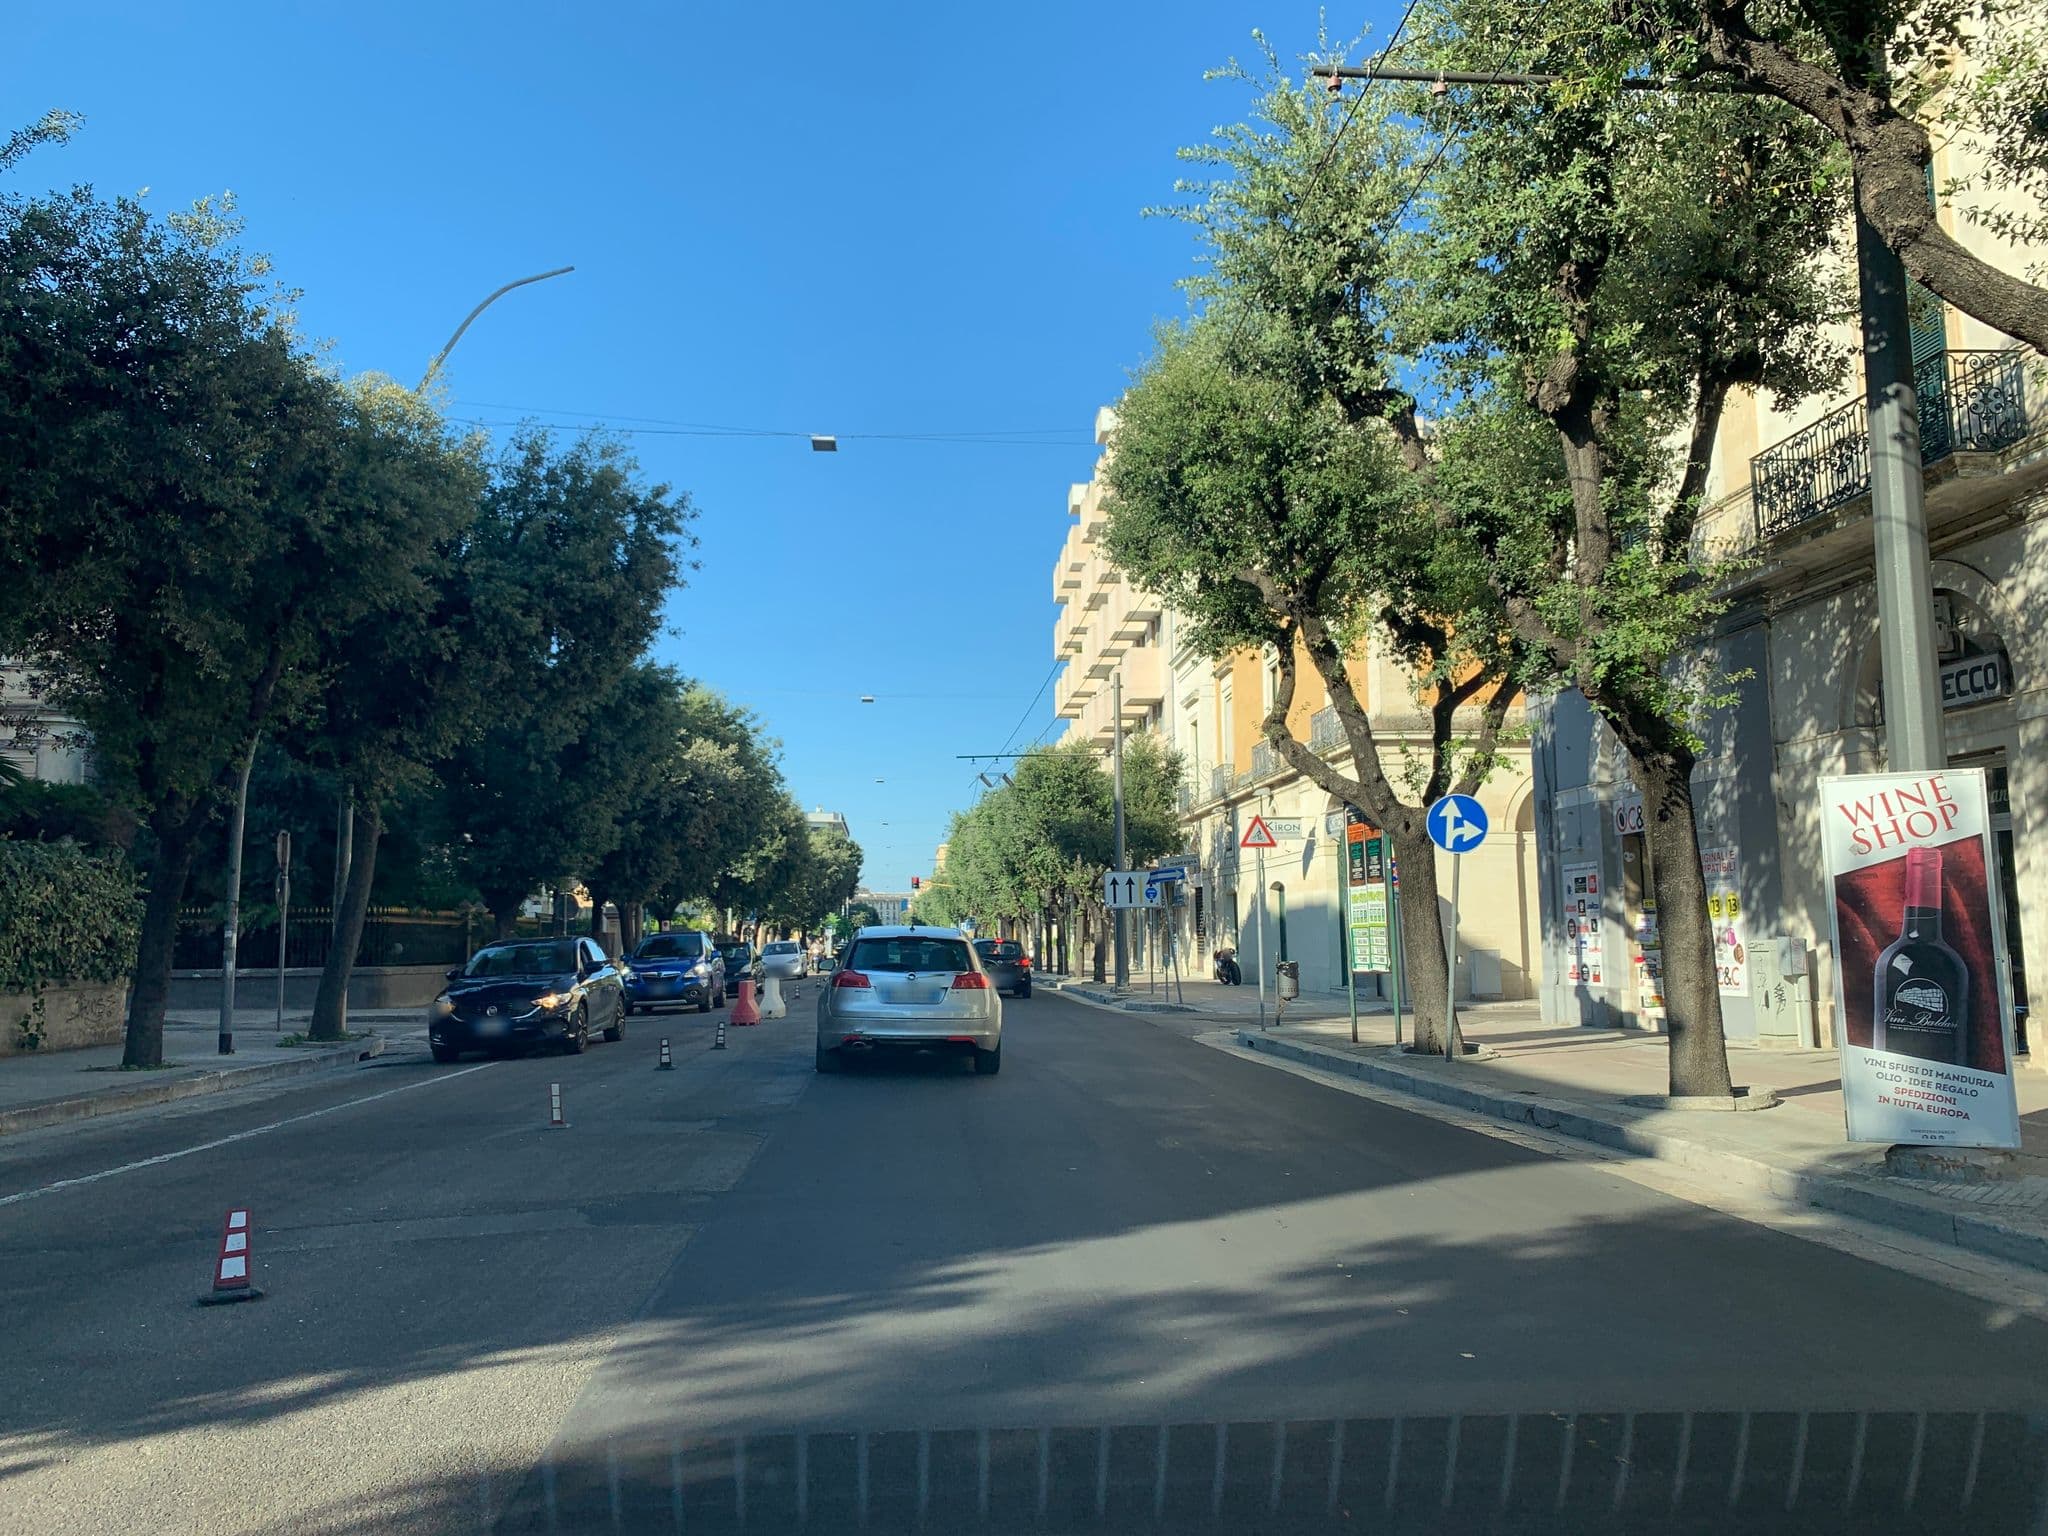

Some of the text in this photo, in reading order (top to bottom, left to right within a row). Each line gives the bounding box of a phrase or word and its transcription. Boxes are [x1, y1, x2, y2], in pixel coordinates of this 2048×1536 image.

[1838, 774, 1953, 828] WINE
[1852, 803, 1959, 855] SHOP
[1711, 898, 1721, 913] 13
[1728, 898, 1738, 912] 13
[1884, 1008, 1905, 1023] Vini
[1864, 1057, 1995, 1089] VINI SFUSI DI MANDURIA
[1876, 1071, 1902, 1083] OLIO
[1908, 1077, 1932, 1089] IDEE
[1935, 1082, 1978, 1098] REGALO
[1878, 1095, 1971, 1121] IN TUTTA EUROPA
[1894, 1087, 1957, 1106] SPEDIZIONI
